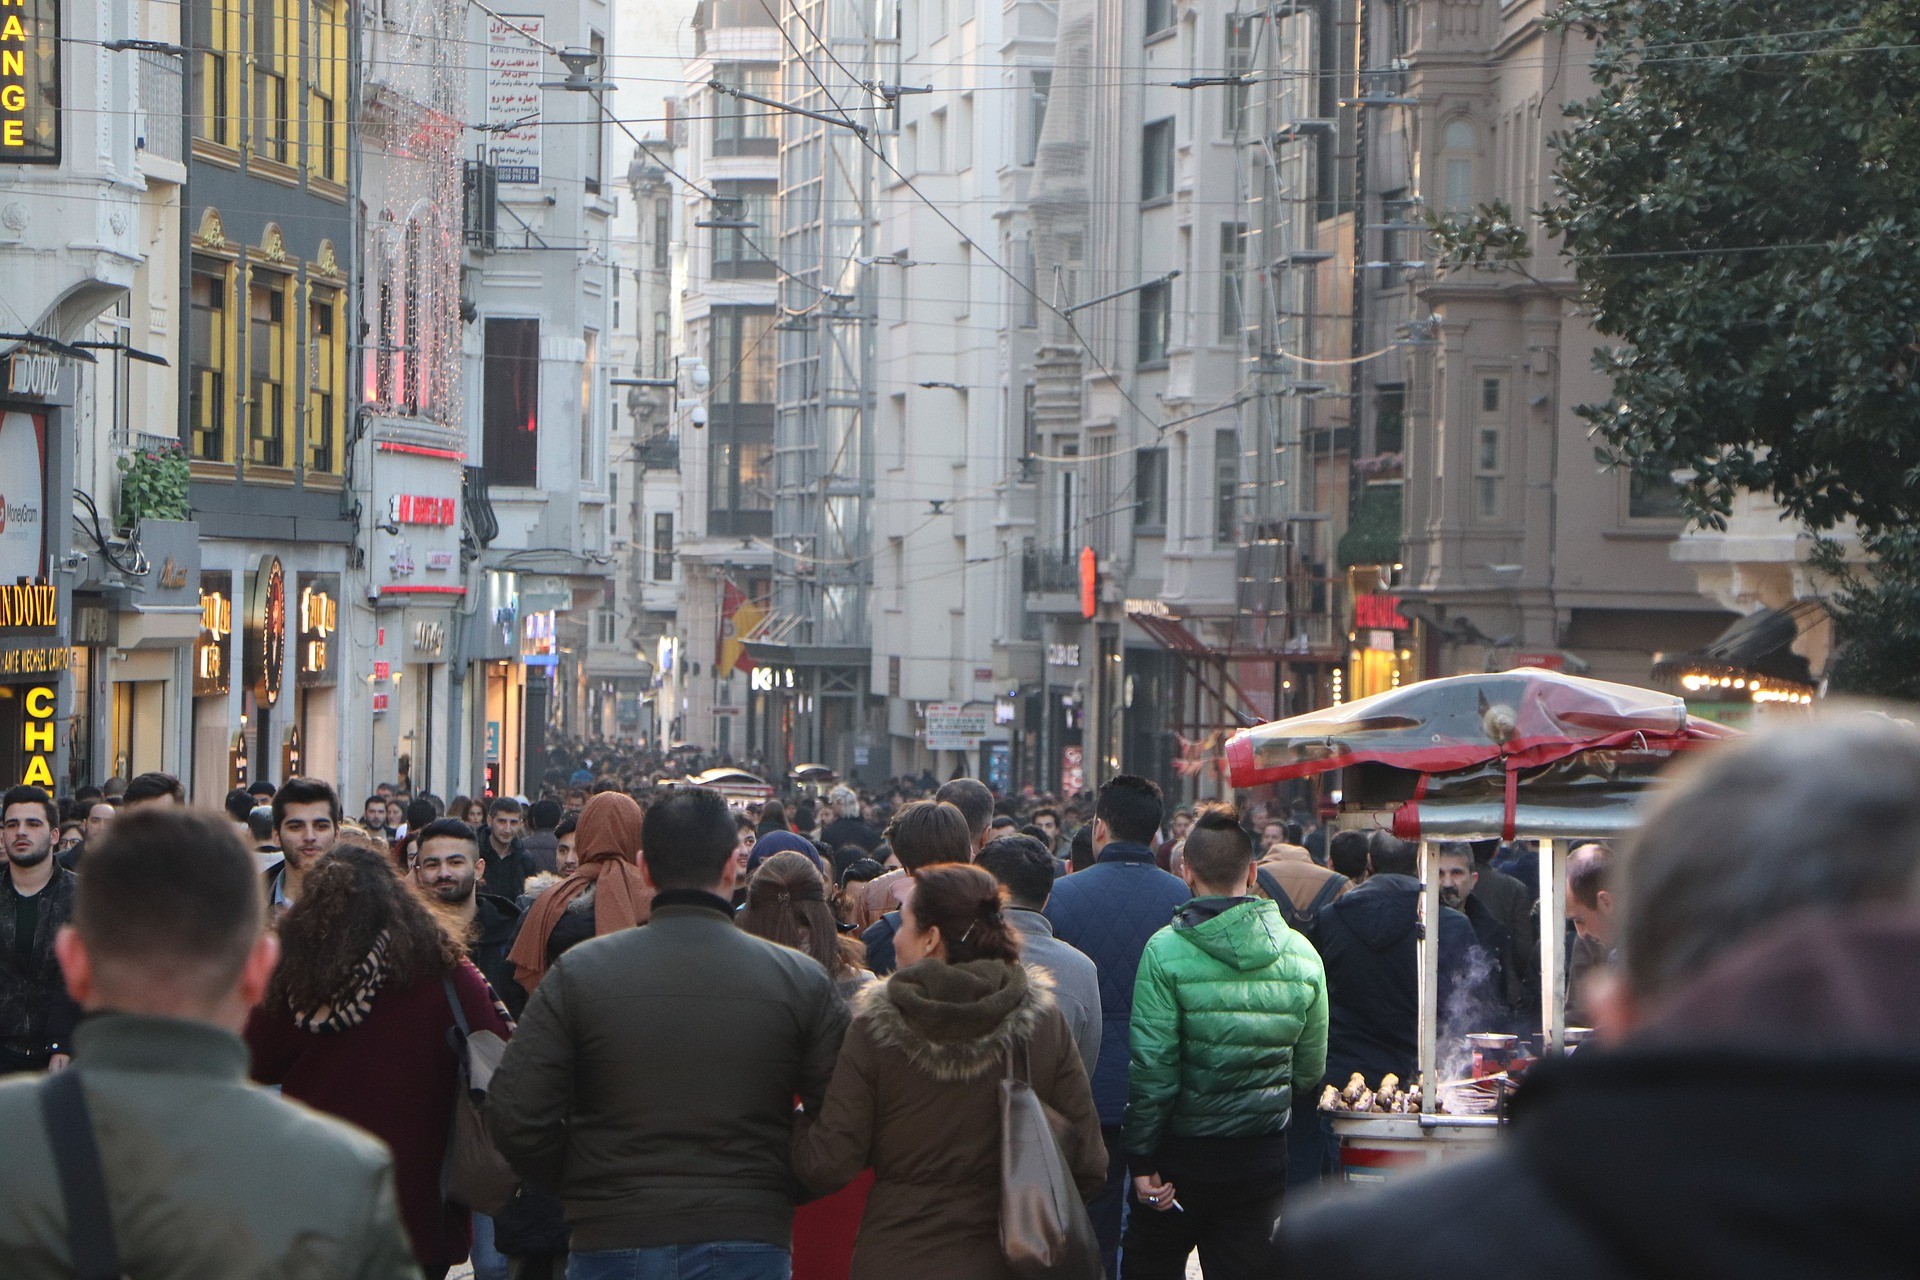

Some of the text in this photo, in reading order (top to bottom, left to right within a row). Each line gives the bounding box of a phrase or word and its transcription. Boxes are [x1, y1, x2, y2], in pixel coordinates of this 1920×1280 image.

[1, 0, 26, 146] ANGE
[14, 576, 56, 627] DÖVİZ
[22, 686, 55, 798] CHA
